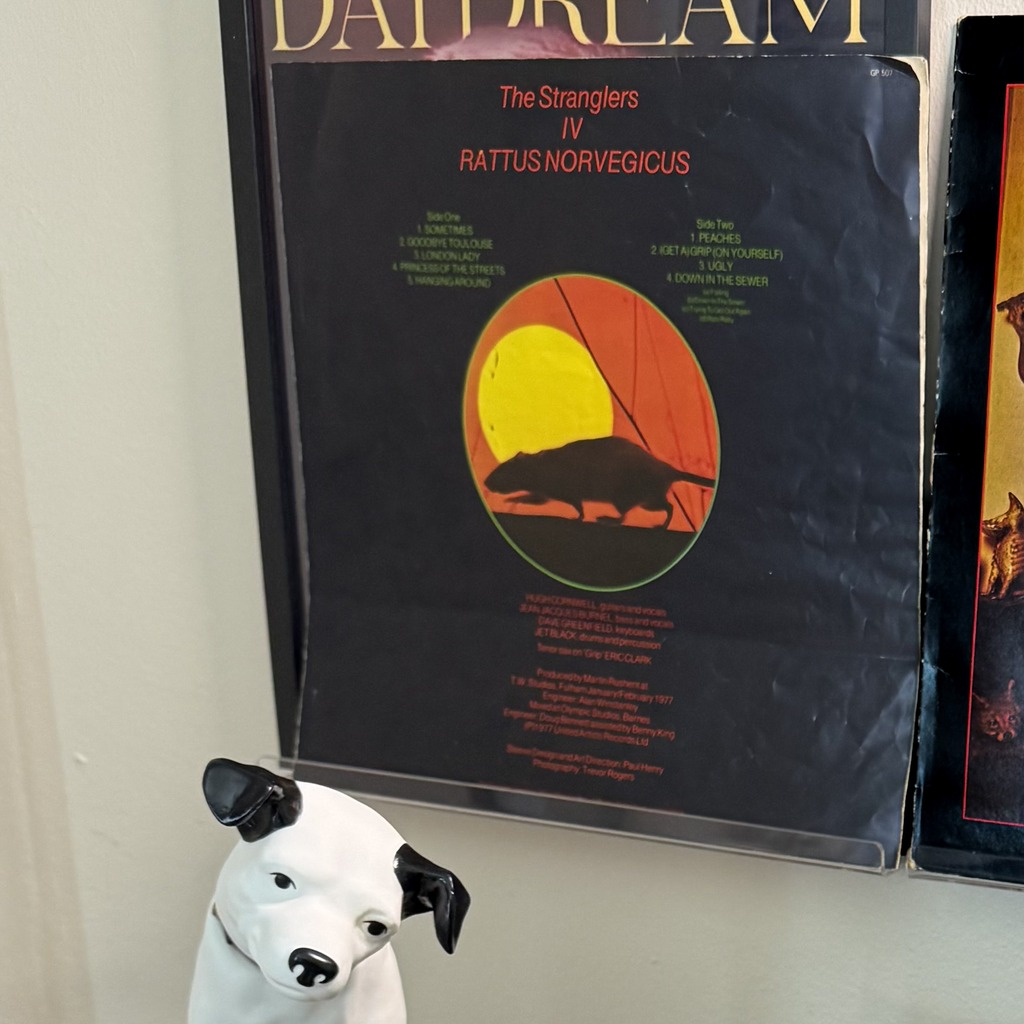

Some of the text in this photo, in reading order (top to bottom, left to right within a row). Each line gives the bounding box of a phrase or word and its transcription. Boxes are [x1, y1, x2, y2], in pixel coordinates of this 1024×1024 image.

[500, 85, 639, 115] The Stranglers
[561, 117, 583, 140] IV
[459, 149, 691, 175] RATTUS NORVEGICUS
[423, 224, 473, 236] SOMETIMES
[695, 219, 734, 230] Side Two
[698, 234, 741, 244] PEACHES
[690, 247, 712, 258] GRIP
[712, 248, 729, 259] (ON
[730, 249, 783, 261] YOURSELF)
[707, 262, 733, 271] UGLY
[675, 274, 704, 284] DOWN
[705, 275, 714, 284] IN
[714, 275, 734, 285] THE
[734, 276, 768, 287] SEWER
[603, 651, 623, 662] ERIC
[622, 653, 652, 666] CLARK
[635, 737, 649, 746] Ltd
